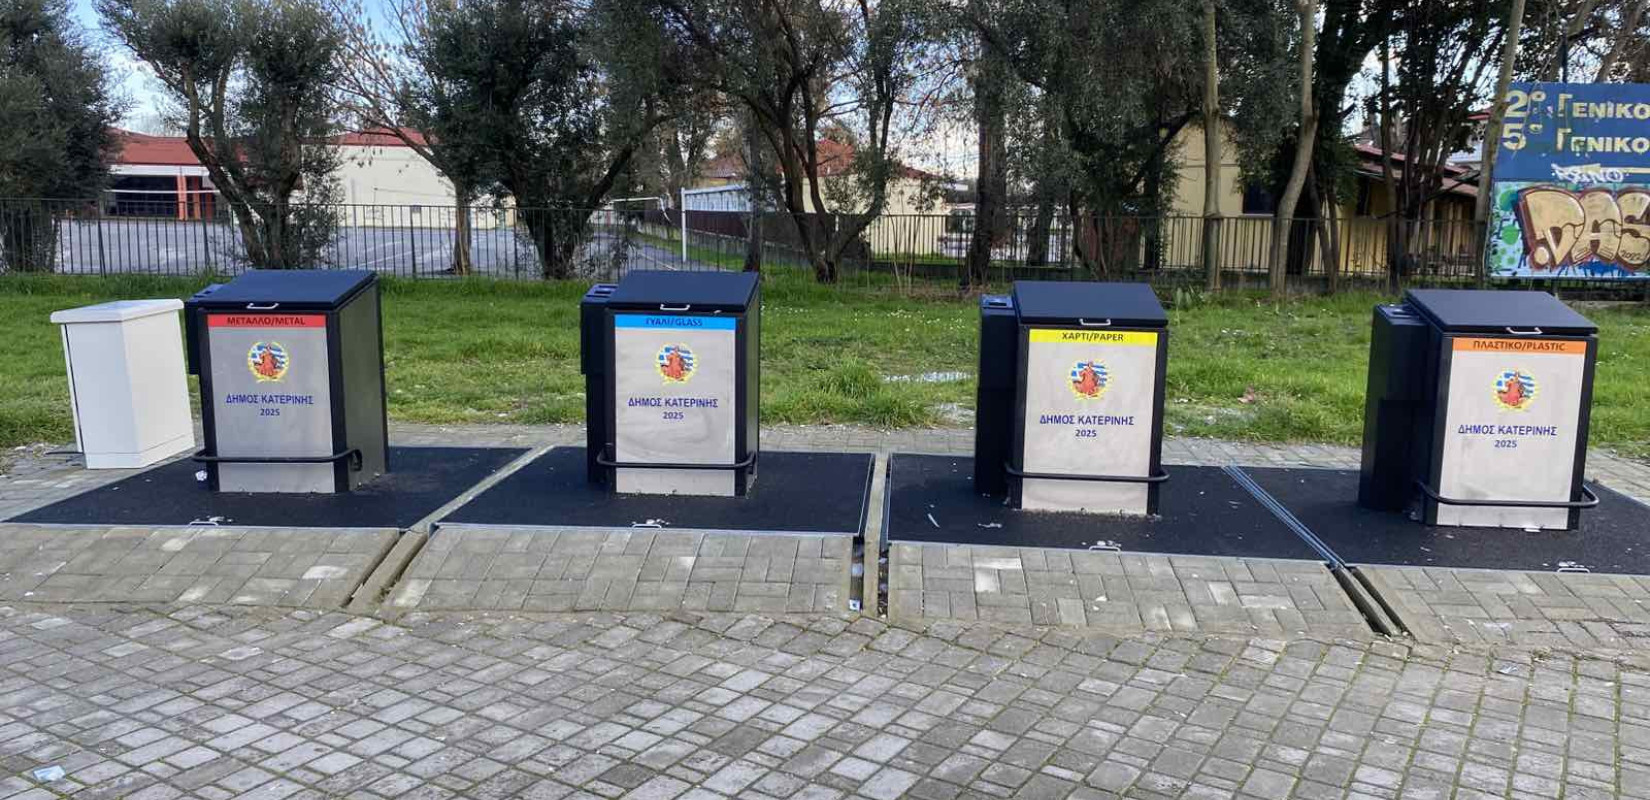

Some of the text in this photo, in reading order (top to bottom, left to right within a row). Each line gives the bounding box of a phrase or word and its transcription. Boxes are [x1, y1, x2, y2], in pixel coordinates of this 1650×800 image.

[227, 316, 306, 326] ΜΕΤΑΛΛΟ/METAL
[645, 317, 703, 327] ΓΥΑΛΙ/GLASS
[1062, 331, 1124, 342] ΧΑΡΤΙ/PAPER
[1473, 340, 1566, 351] ΠΛΑΣΤΙΚΟ/PLASTIC
[225, 393, 315, 405] ΔΗΜΟΣ ΚΑΤΕΡΙΝΗΣ
[628, 397, 719, 408] ΔΗΜΟΣ ΚΑΤΕΡΙΝΗΣ
[259, 408, 280, 416] 2025
[662, 411, 684, 420] 2025
[1039, 414, 1135, 426] ΔΗΜΟΣ ΚΑΤΕΡΙΝΗΣ
[1074, 429, 1097, 437] 2025
[1457, 424, 1558, 436] ΔΗΜΟΣ ΚΑΤΕΡΙΝΗΣ
[1494, 439, 1518, 448] 2025
